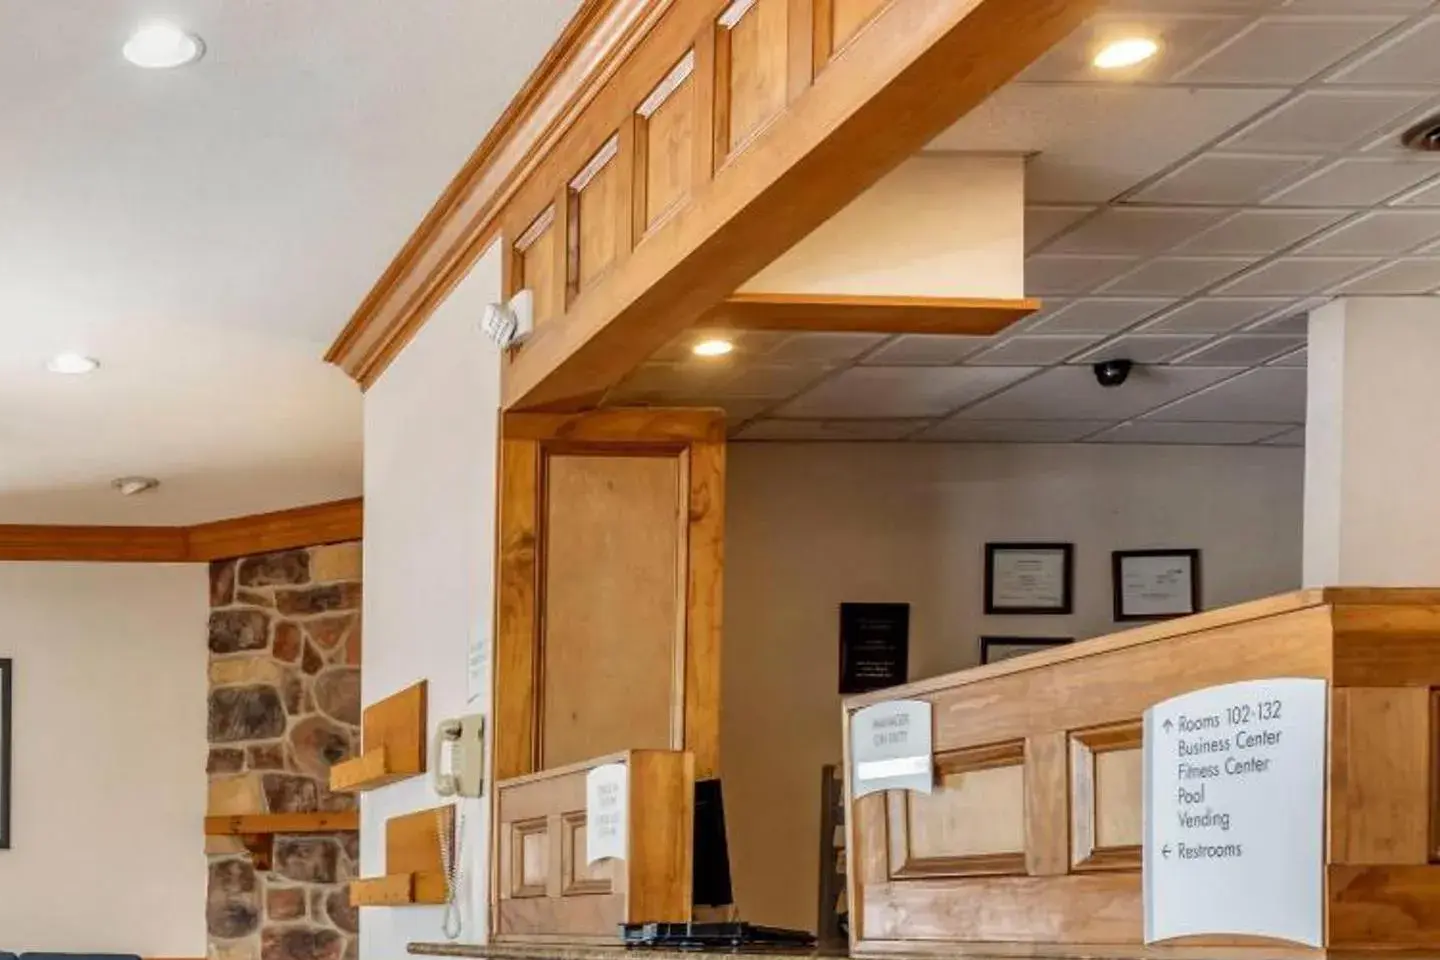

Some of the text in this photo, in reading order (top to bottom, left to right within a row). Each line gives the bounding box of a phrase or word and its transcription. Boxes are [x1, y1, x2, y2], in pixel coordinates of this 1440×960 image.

[1178, 700, 1282, 732] Rooms 102-132
[1178, 730, 1282, 757] Business Center
[1178, 756, 1270, 780] Fitness Center
[1178, 784, 1205, 804] Pool
[1177, 809, 1230, 830] Vending
[1178, 842, 1243, 860] Restrooms
